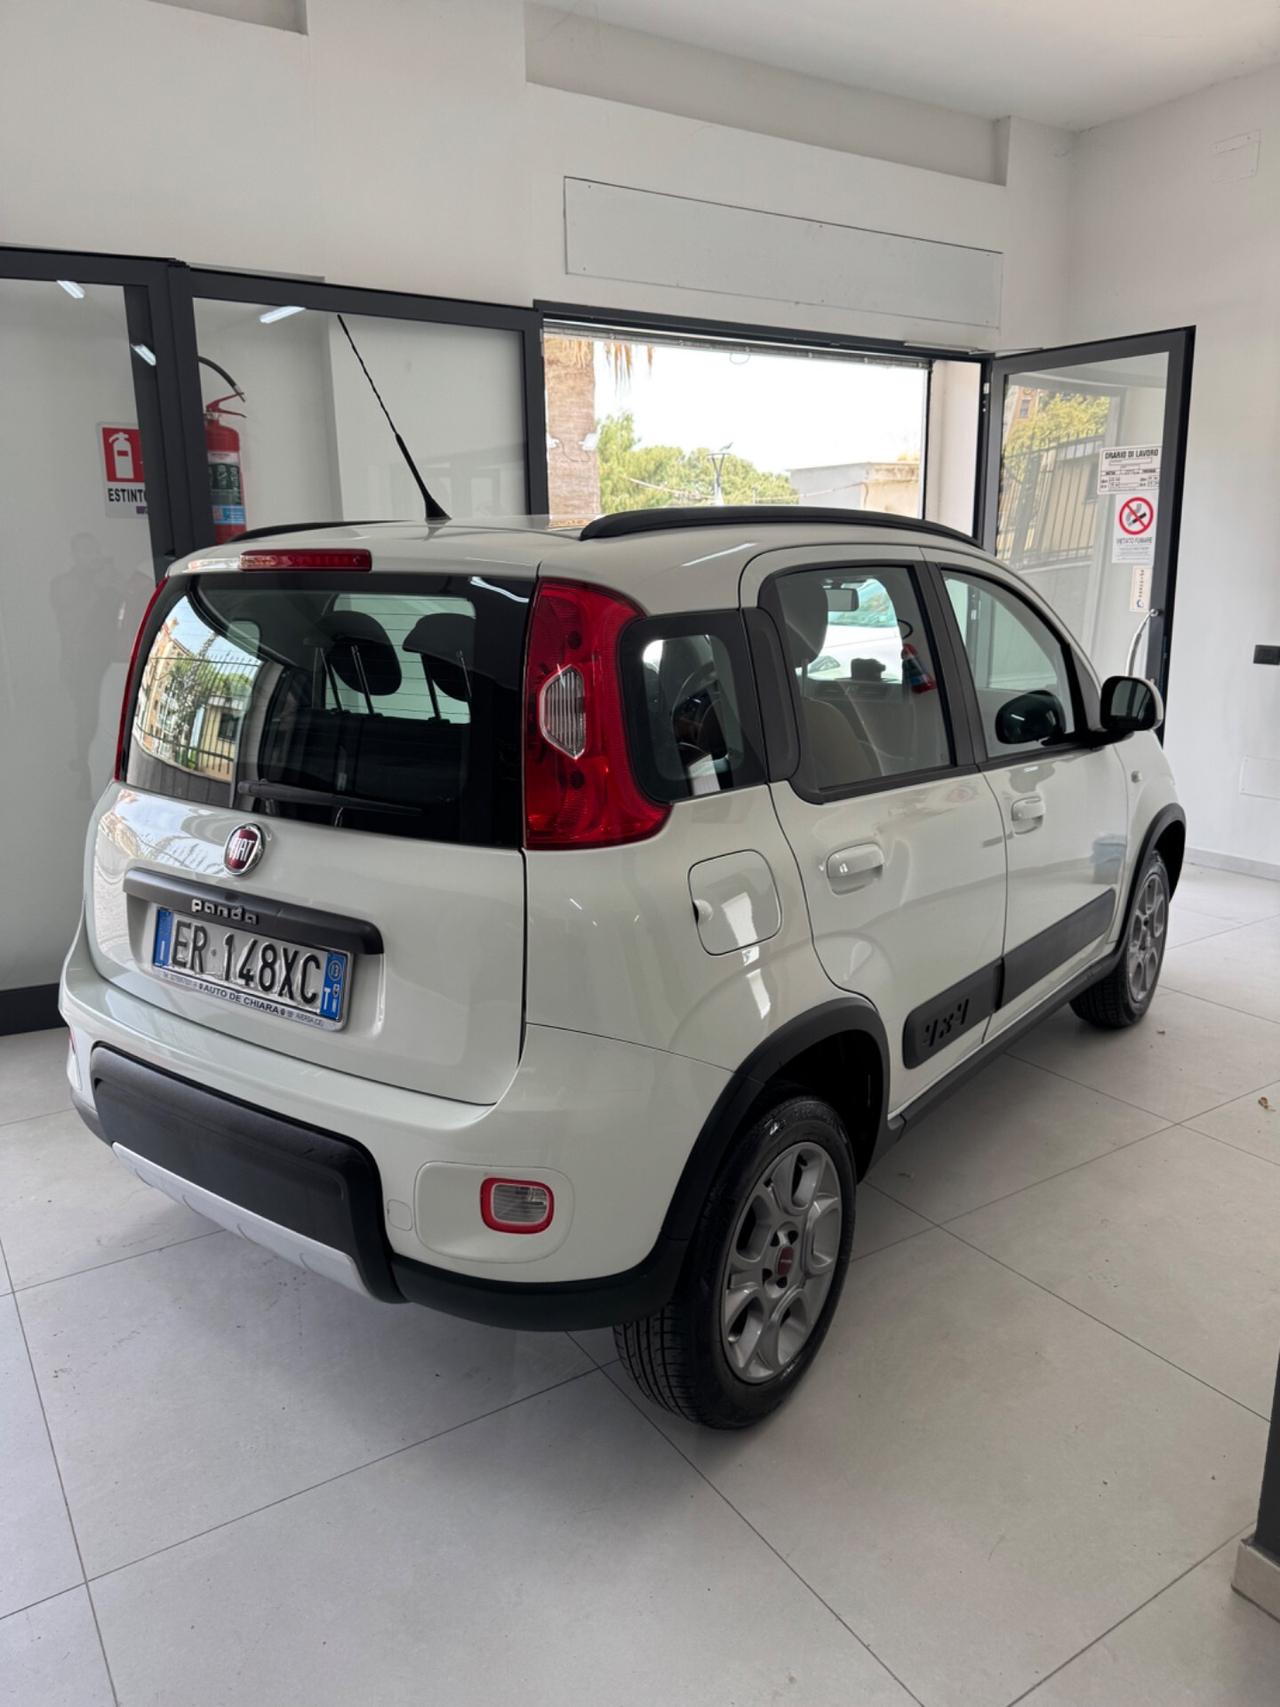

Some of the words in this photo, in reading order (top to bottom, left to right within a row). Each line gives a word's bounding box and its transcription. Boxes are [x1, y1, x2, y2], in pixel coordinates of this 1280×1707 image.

[1104, 451, 1127, 459] ORARIO
[1127, 450, 1135, 458] DI
[1135, 449, 1159, 457] LAVORO
[228, 837, 255, 861] FIAT
[171, 919, 208, 974] ER
[223, 933, 321, 1005] 148XC
[203, 985, 228, 999] AUTO
[229, 991, 242, 1004] DE
[243, 995, 280, 1016] CHIARA
